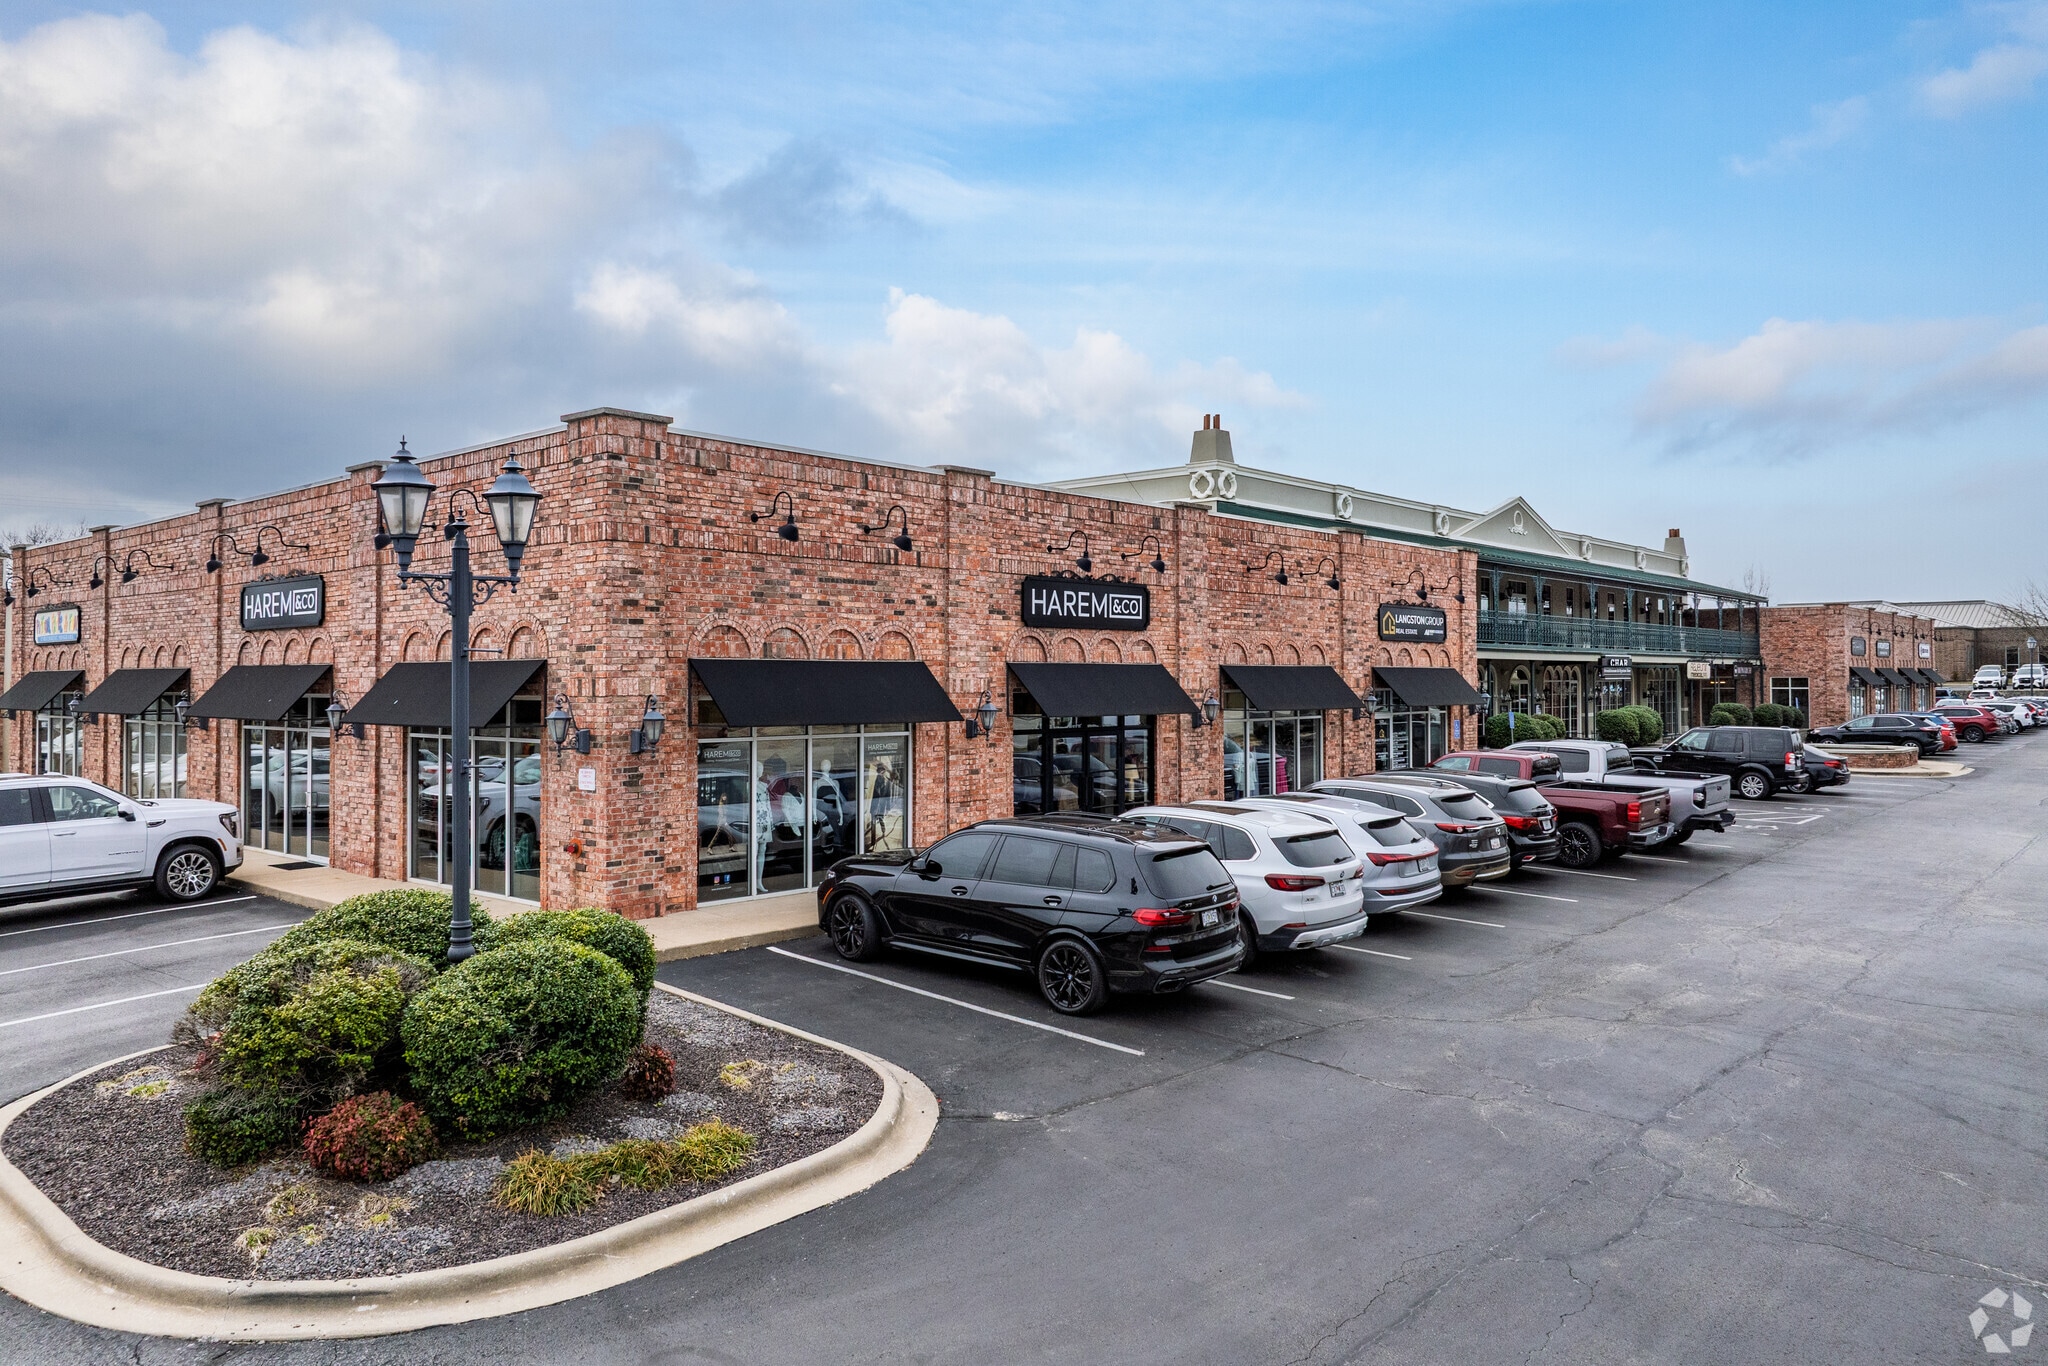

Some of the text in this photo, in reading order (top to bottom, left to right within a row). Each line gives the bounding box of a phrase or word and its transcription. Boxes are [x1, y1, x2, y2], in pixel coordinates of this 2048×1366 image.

[245, 591, 315, 619] HAREM &CO
[1031, 588, 1139, 618] HAREM &CO
[1395, 614, 1444, 626] LANGSTON GROUP
[1610, 658, 1628, 667] CHAR
[867, 743, 888, 751] HAREM
[704, 750, 729, 758] HAREM
